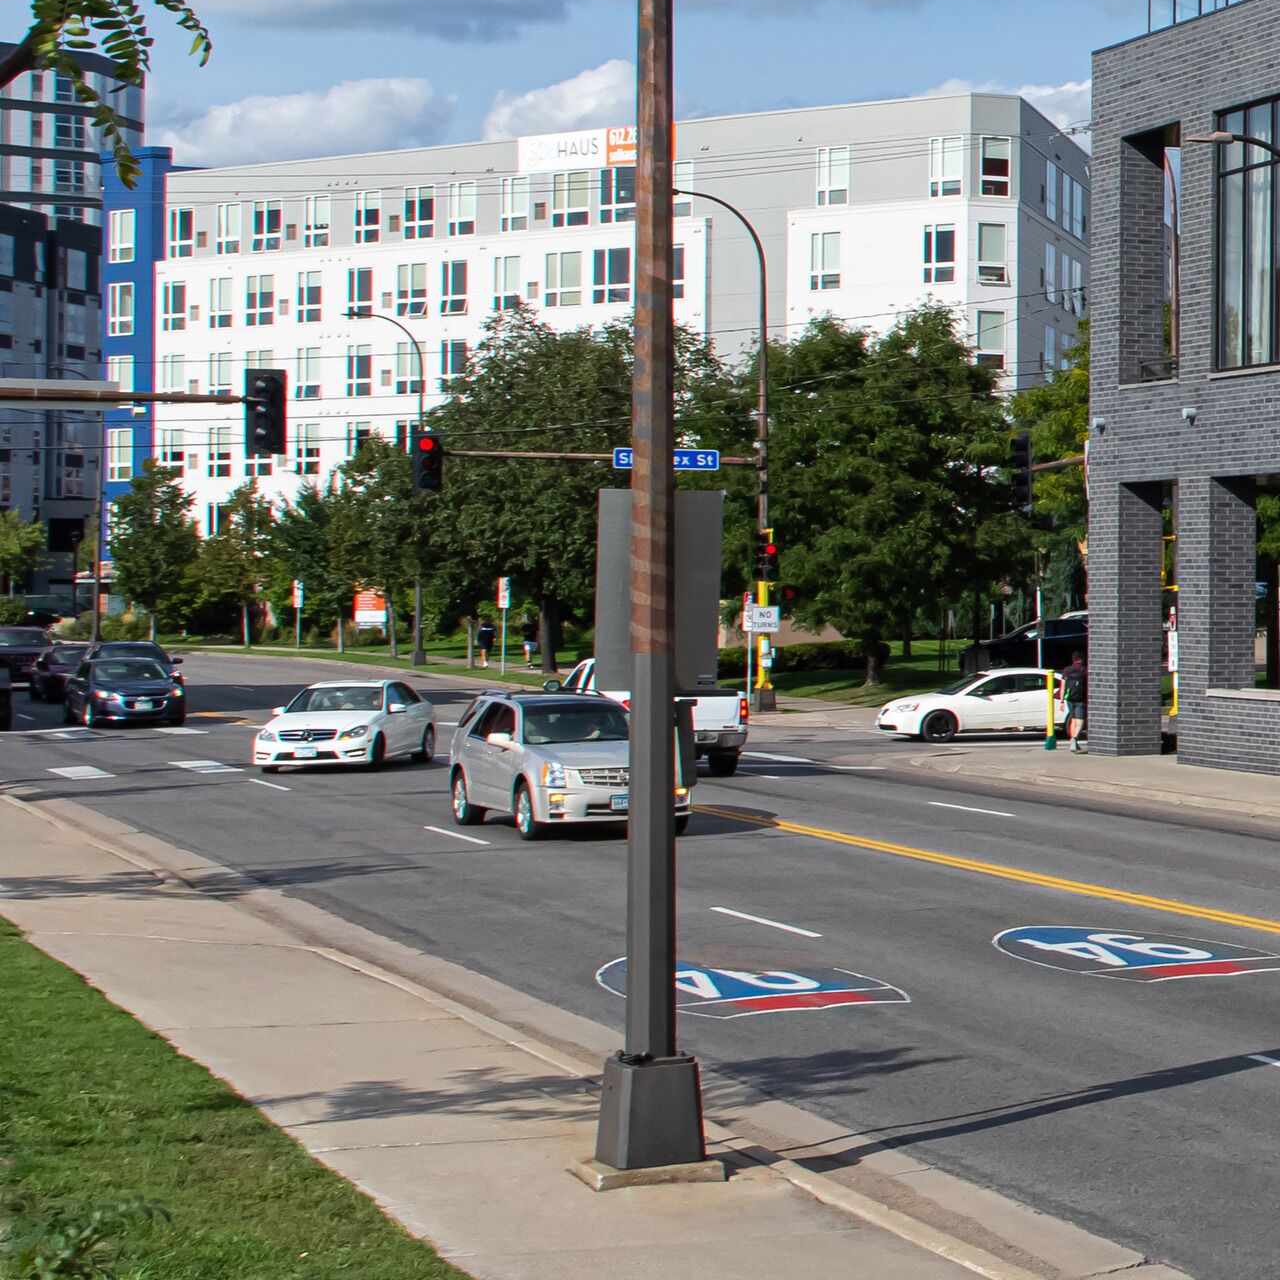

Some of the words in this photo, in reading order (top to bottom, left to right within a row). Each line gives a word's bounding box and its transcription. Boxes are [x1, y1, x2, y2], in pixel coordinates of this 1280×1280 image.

[697, 454, 713, 466] St
[759, 611, 772, 619] NO
[1016, 933, 1214, 967] 94
